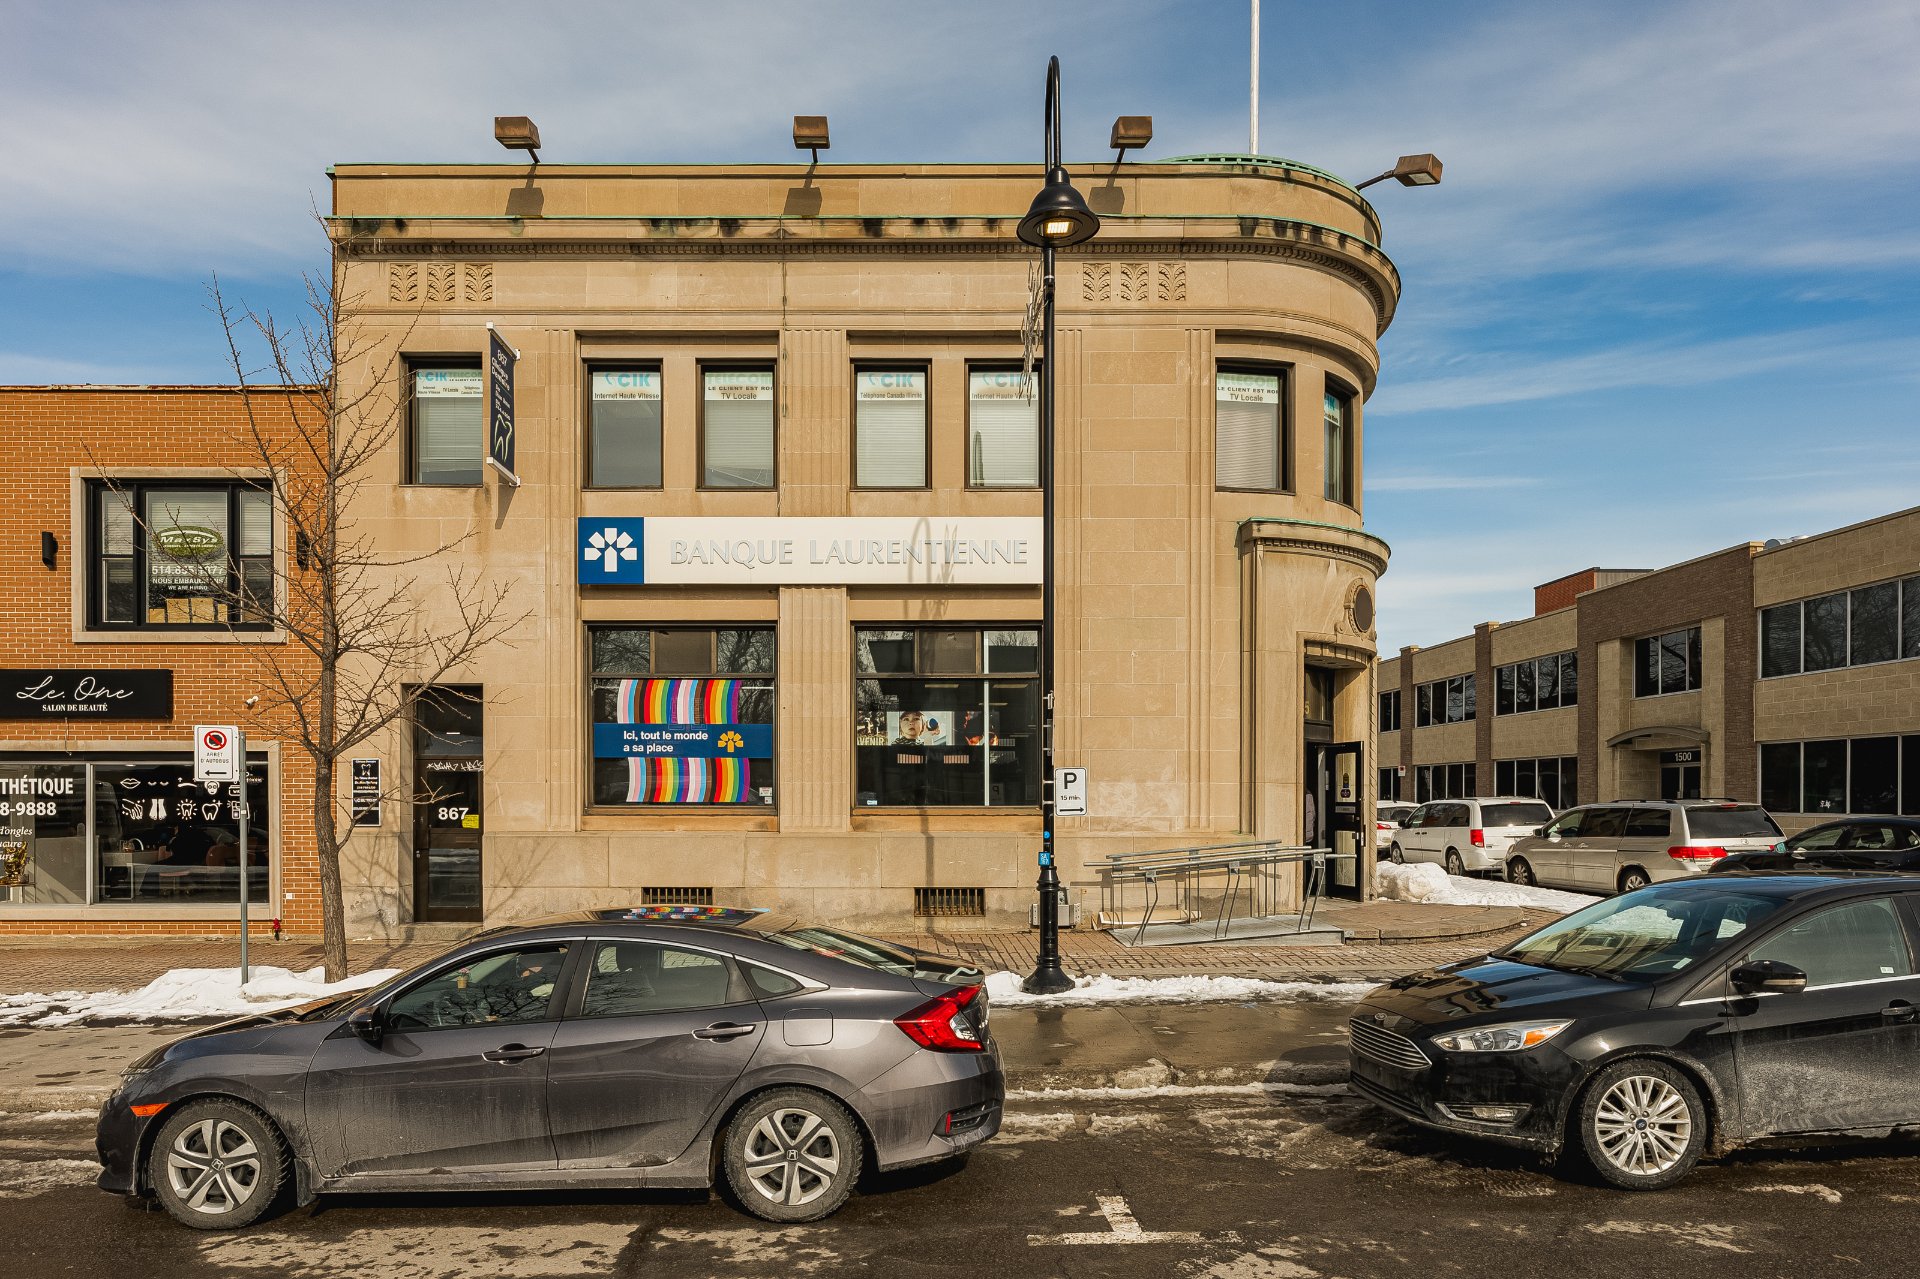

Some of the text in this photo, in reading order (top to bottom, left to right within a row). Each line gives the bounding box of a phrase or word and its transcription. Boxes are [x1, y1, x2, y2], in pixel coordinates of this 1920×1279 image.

[425, 371, 448, 382] CIK
[617, 373, 651, 387] CIK
[880, 373, 914, 388] CIK
[594, 392, 660, 400] Internet Haute Vitesse
[721, 392, 758, 400] TV Locale
[972, 392, 995, 400] Internet
[995, 392, 1014, 400] Haute
[1230, 393, 1264, 402] TV Locale
[670, 539, 1028, 570] BANQUE LAURENTIENNE
[74, 676, 134, 701] One
[42, 702, 108, 712] SALON DE BEAUTÉ
[623, 730, 709, 741] Ici, tout le monde
[623, 743, 674, 755] a sa place
[1674, 751, 1692, 762] 1500
[0, 774, 74, 797] THÉTIQUE
[1063, 772, 1078, 790] P
[0, 801, 57, 816] 8-9888
[438, 807, 469, 821] 867
